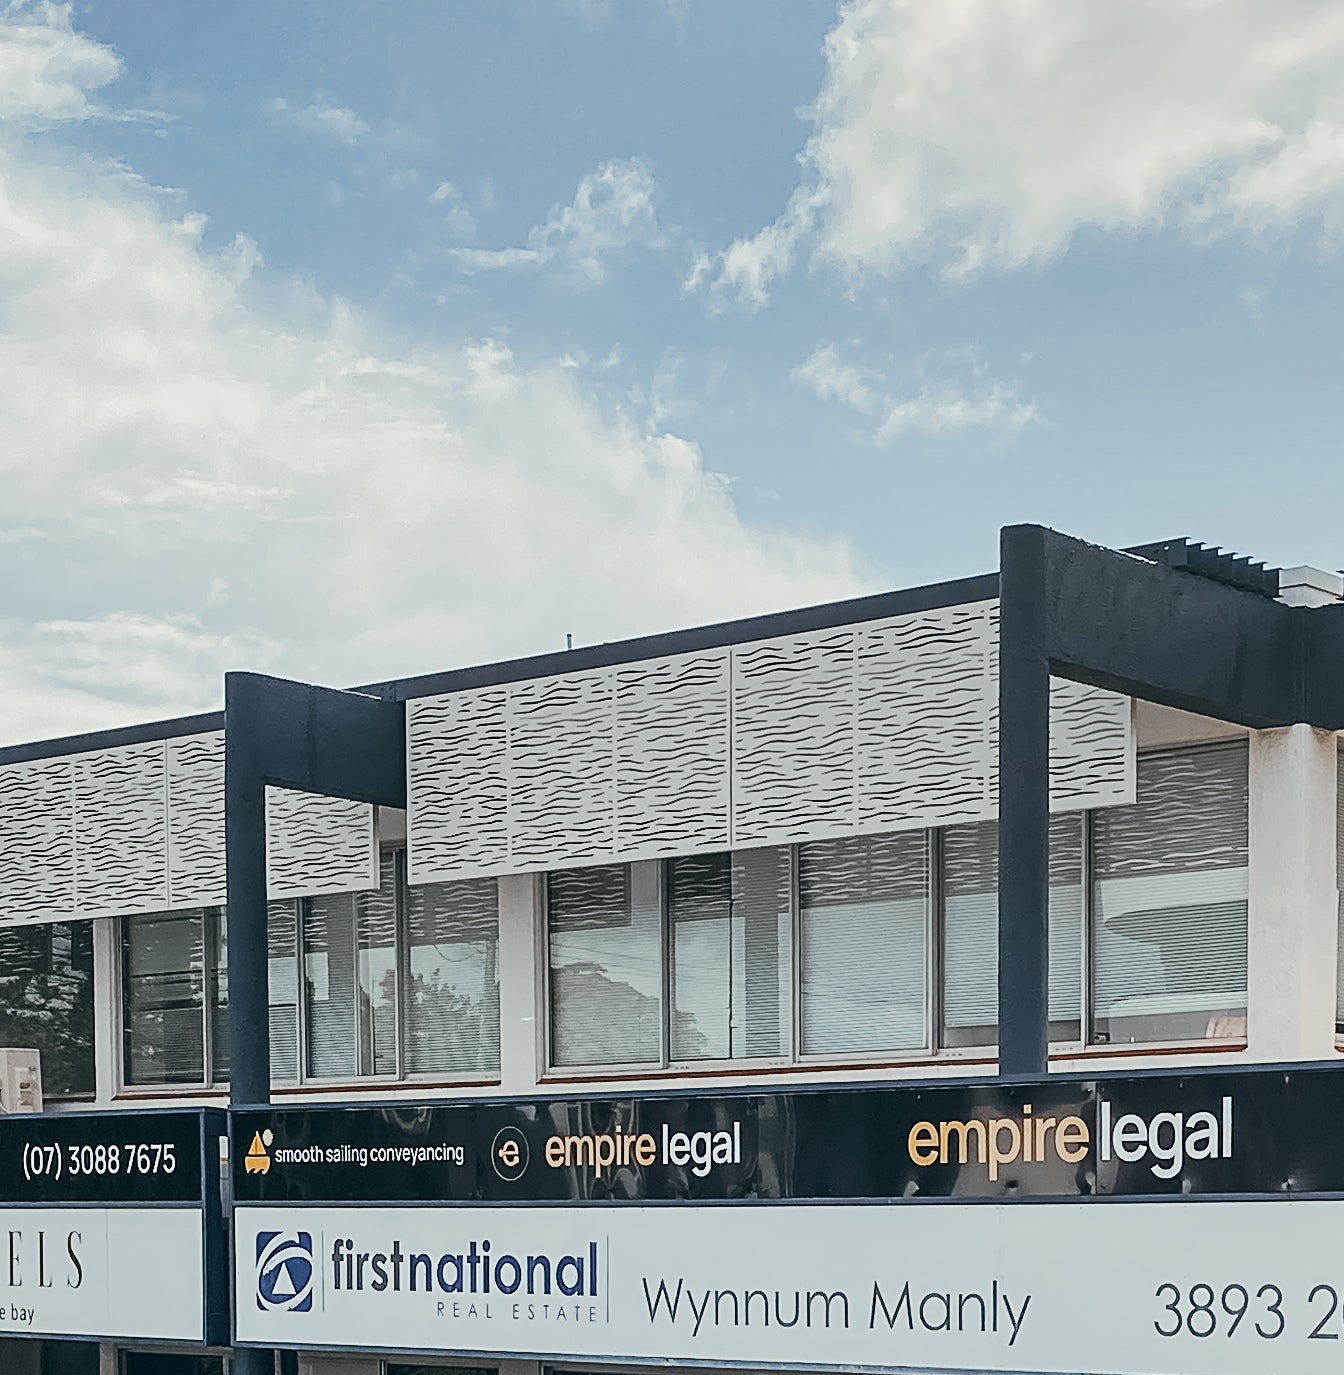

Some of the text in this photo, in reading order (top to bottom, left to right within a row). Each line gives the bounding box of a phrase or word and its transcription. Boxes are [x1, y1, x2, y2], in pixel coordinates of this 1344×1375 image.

[23, 1142, 62, 1181] (07)
[68, 1144, 120, 1175] 3088
[125, 1143, 177, 1175] 7675
[275, 1143, 464, 1168] smooth sailing conveyancing
[544, 1121, 741, 1179] empire legal
[907, 1096, 1233, 1182] empire legal
[11, 1303, 35, 1326] bay
[436, 1301, 598, 1323] REAL ESTATE
[641, 1276, 1031, 1347] Wynnum Manly
[1154, 1283, 1286, 1339] 3893
